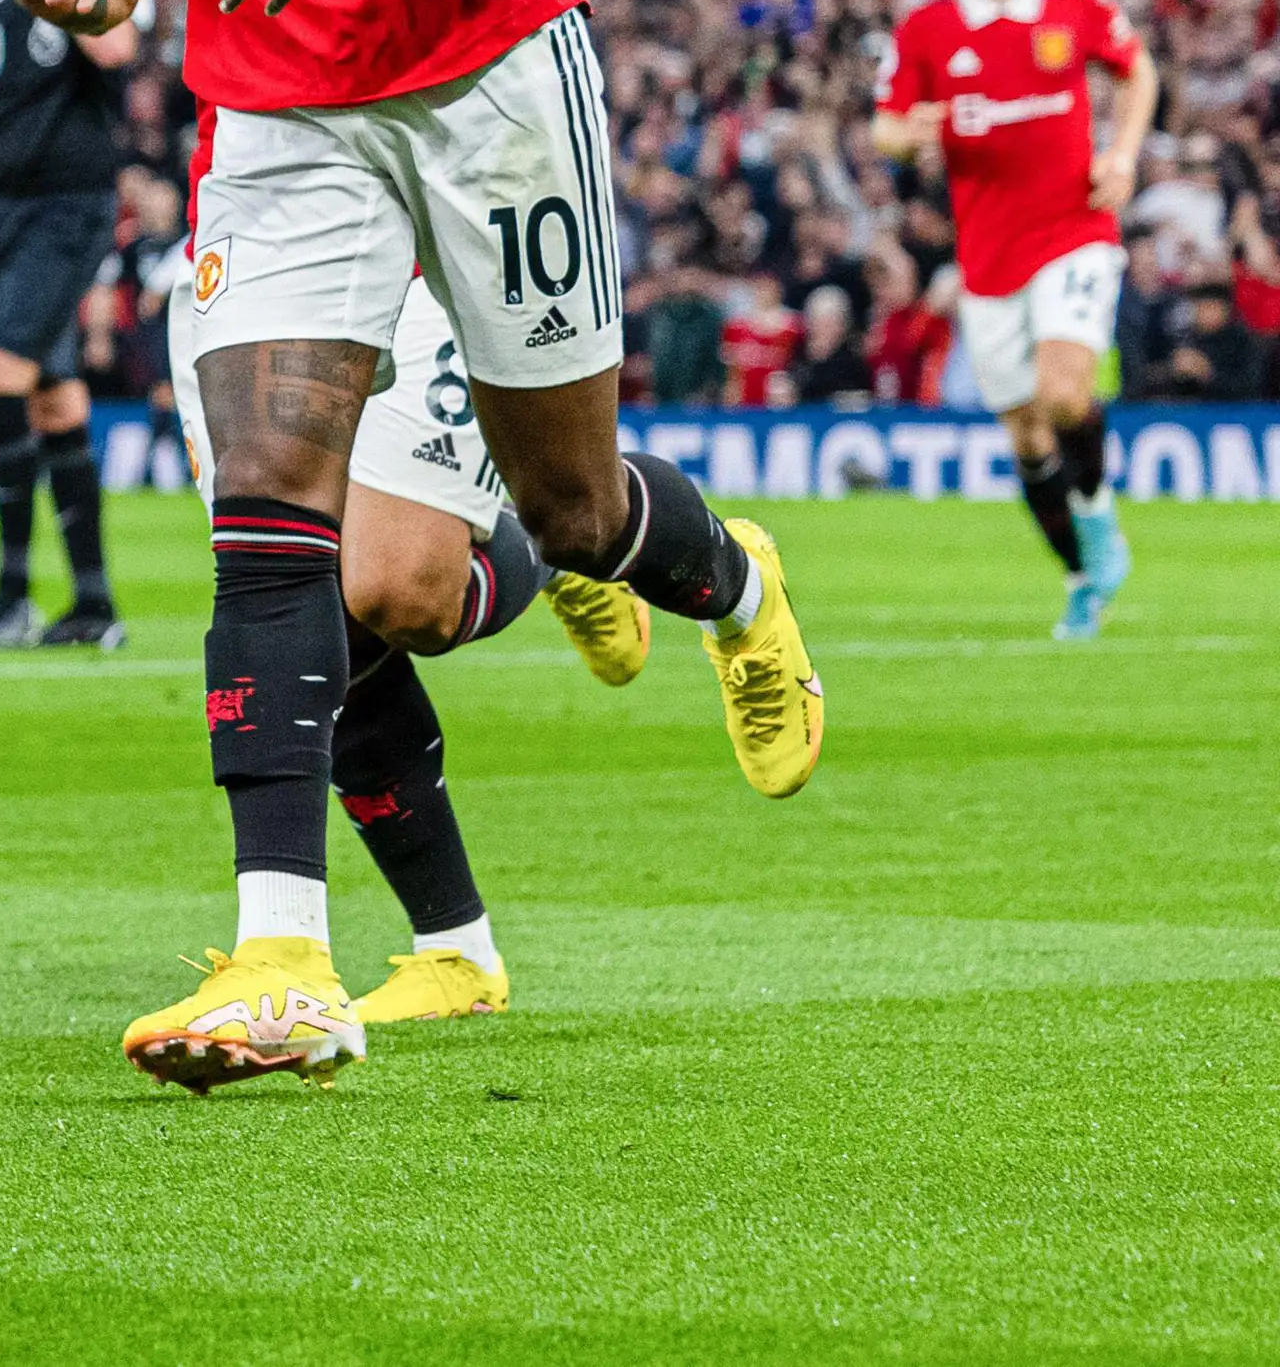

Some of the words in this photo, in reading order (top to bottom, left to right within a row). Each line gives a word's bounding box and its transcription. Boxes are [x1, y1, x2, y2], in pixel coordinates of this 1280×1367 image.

[487, 195, 582, 306] 10
[524, 324, 578, 349] adidas
[425, 339, 476, 427] 8
[411, 446, 462, 472] adidas
